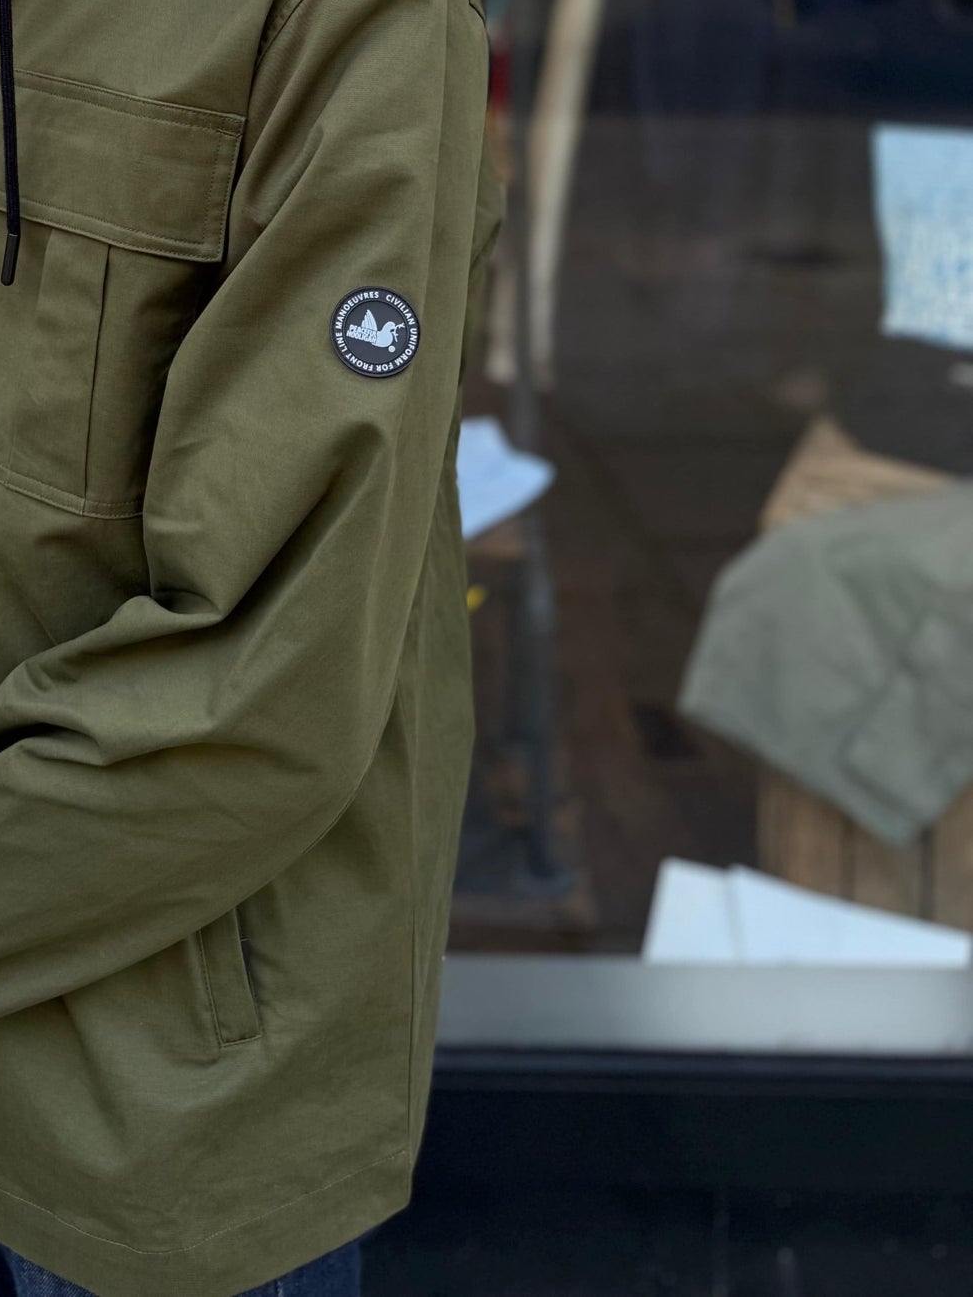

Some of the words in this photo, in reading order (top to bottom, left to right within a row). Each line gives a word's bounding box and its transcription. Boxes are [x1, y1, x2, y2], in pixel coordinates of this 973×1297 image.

[335, 292, 379, 330] MANOEUVRES
[385, 294, 416, 324] CIVILIAN
[335, 332, 347, 352] LINE
[346, 330, 377, 344] HOOLIGAN
[396, 328, 417, 366] UNIFORM
[345, 353, 373, 371] FRONT
[377, 364, 394, 372] FOR
